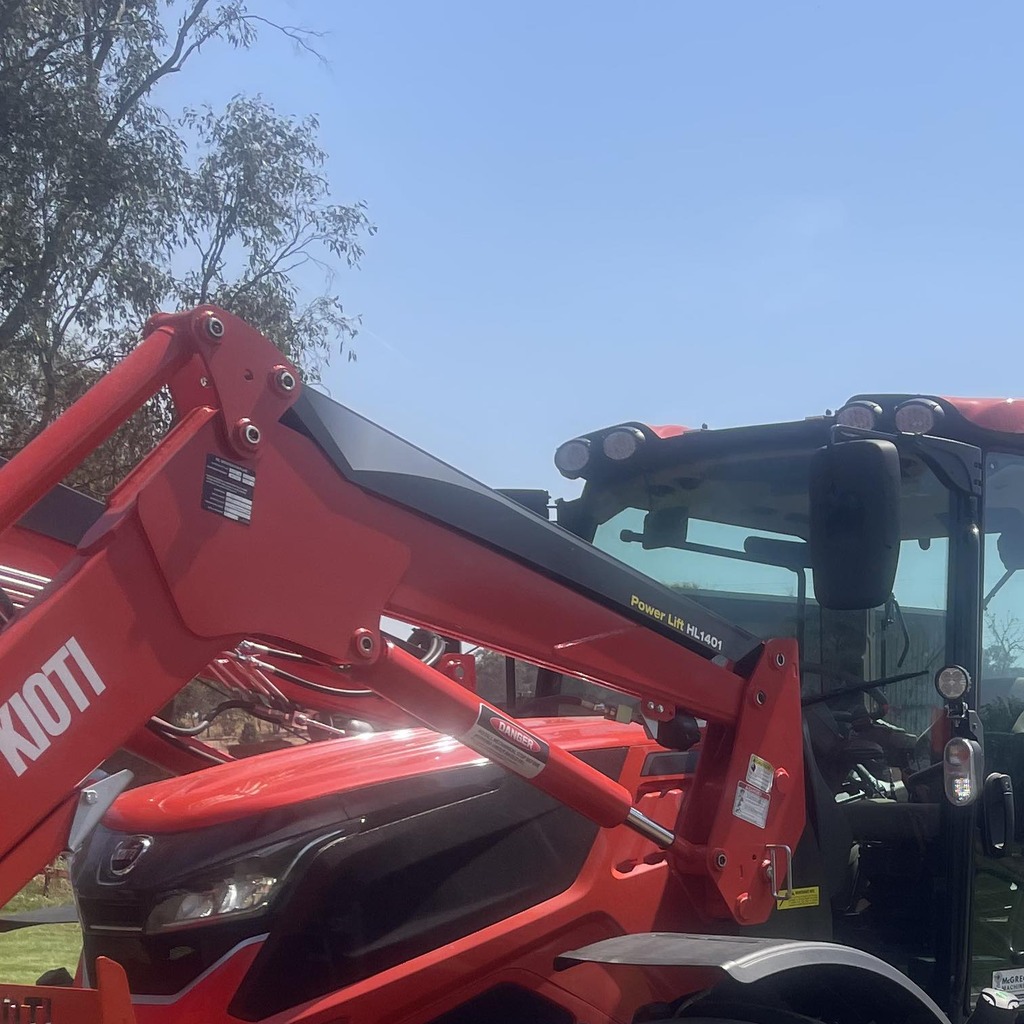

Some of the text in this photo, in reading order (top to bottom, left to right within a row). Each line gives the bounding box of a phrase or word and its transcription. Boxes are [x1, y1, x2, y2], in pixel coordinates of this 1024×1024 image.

[630, 594, 722, 651] Power Lift HL1401
[0, 636, 107, 778] KIOTI
[498, 721, 534, 750] DANGER
